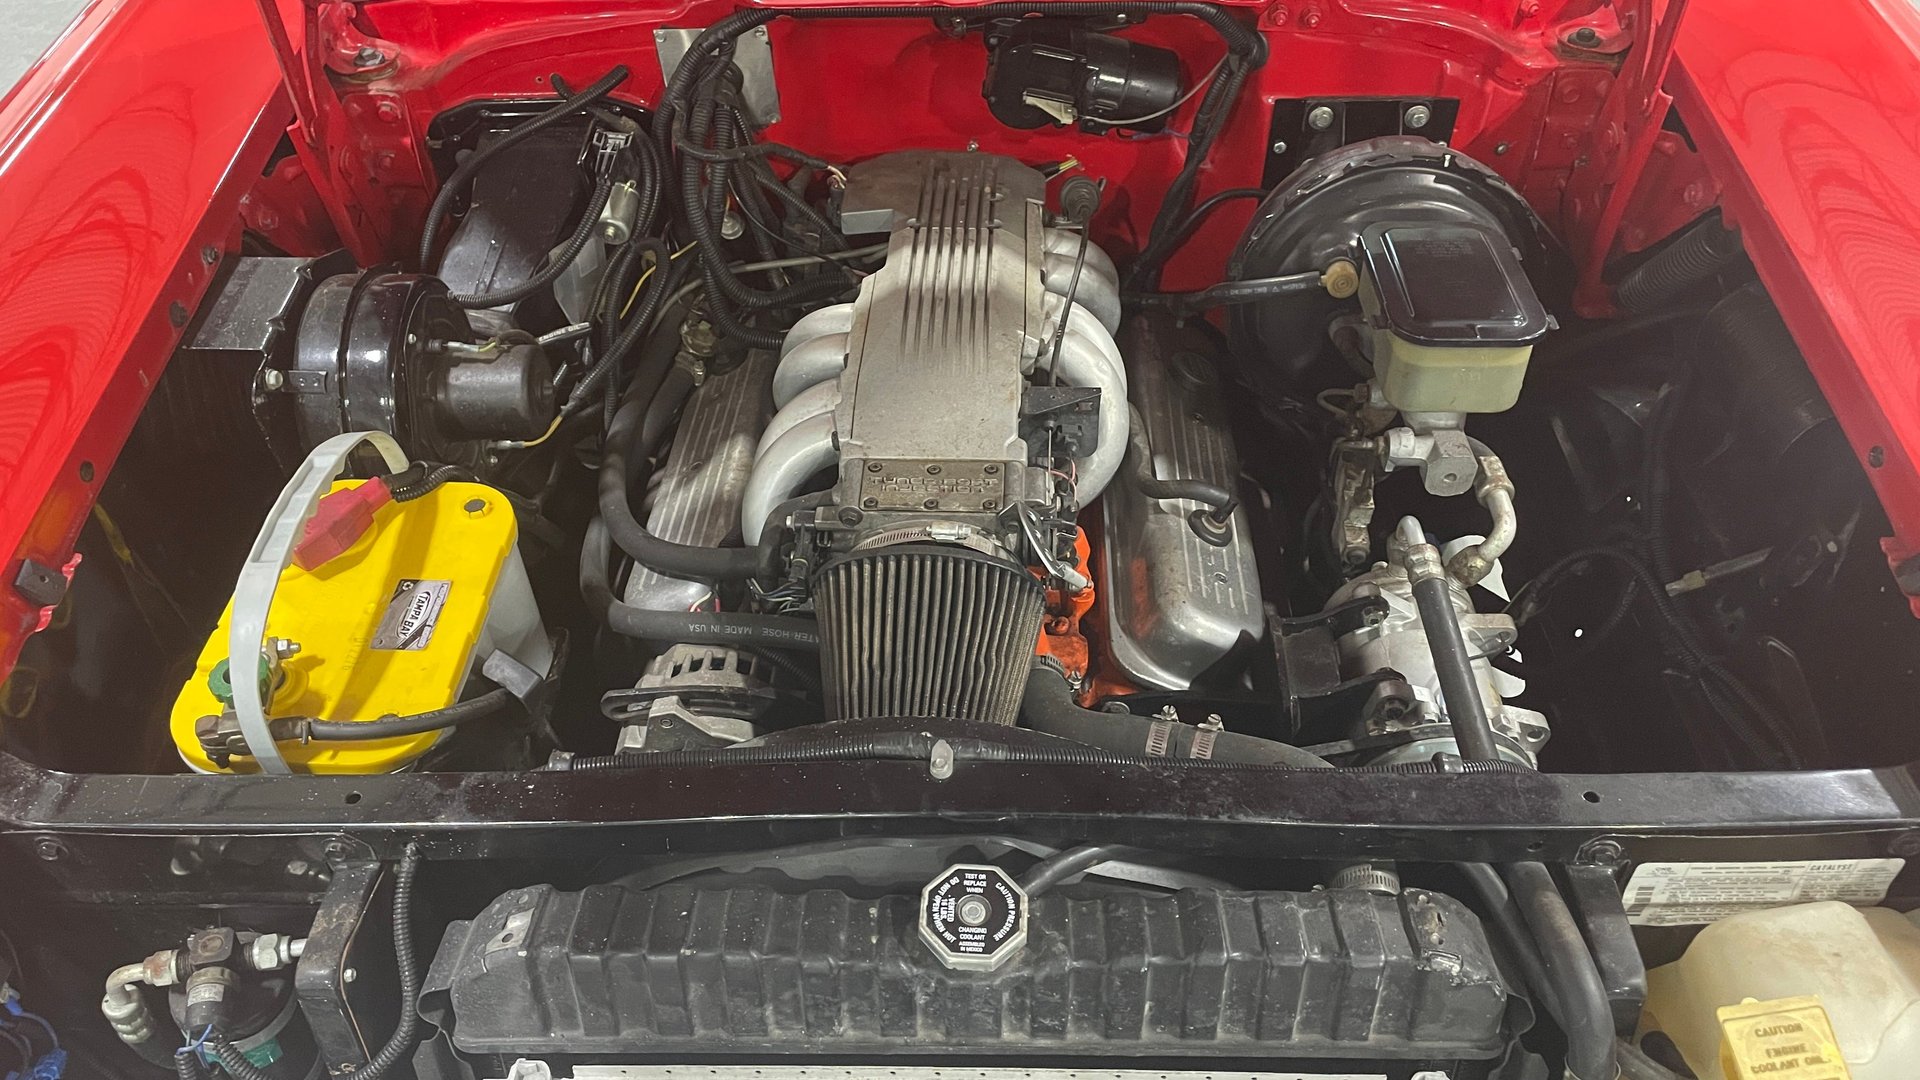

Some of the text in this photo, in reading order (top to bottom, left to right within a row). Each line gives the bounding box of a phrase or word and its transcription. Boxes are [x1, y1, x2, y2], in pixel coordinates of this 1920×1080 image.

[881, 484, 984, 494] INJECTION
[400, 595, 429, 638] TAMPA BAY
[689, 623, 820, 644] TER HOSE MADE IN USA
[1809, 863, 1853, 871] CATALYST
[963, 879, 987, 887] REPLACE
[964, 872, 978, 880] TEST
[932, 876, 960, 943] DO NOT OPEN WHEN HOT
[947, 897, 955, 922] VENTED
[992, 882, 1016, 942] CAUTION PRESSURE
[958, 926, 988, 934] CHANGING
[959, 933, 986, 941] COOLANT
[1754, 1023, 1804, 1038] CAUTION
[1765, 1042, 1809, 1059] ENGINE
[1750, 1058, 1801, 1075] COOLANT
